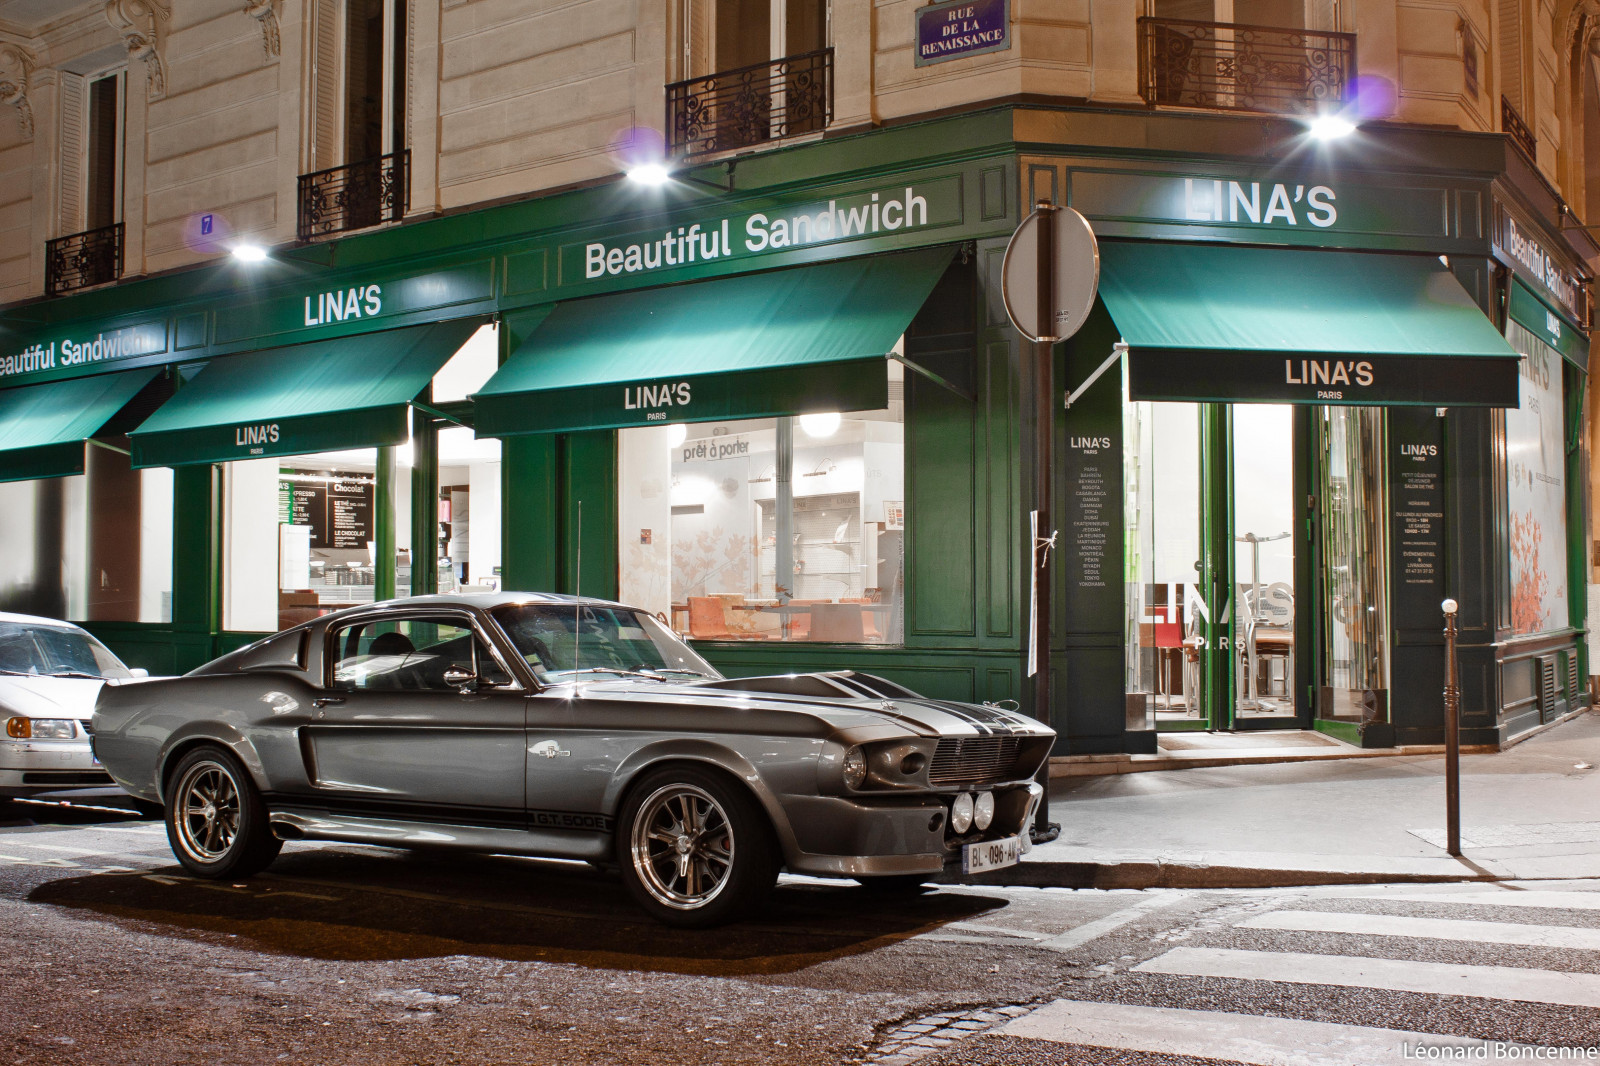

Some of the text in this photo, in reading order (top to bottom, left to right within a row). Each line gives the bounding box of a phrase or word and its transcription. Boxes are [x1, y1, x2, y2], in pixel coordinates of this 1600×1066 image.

[948, 6, 974, 21] RUE
[942, 19, 980, 36] DE LA
[922, 28, 1003, 55] RENAISSANCE
[1184, 178, 1338, 228] LINA'S
[203, 217, 210, 234] 7
[585, 187, 927, 279] Beautiful Sandwich
[1509, 217, 1545, 283] Beautiful
[304, 284, 382, 327] LINA'S
[60, 327, 143, 366] Sandwich
[1285, 359, 1374, 387] LINA'S
[624, 382, 691, 410] LINA'S
[1317, 390, 1343, 400] PARIS
[647, 412, 666, 421] PARIS
[236, 424, 280, 446] LINA'S
[1070, 437, 1111, 449] LINA'S
[683, 439, 749, 463] prêt à porter
[1401, 444, 1438, 456] LINA'S
[334, 483, 364, 493] Chocolat
[1194, 636, 1246, 650] PRS
